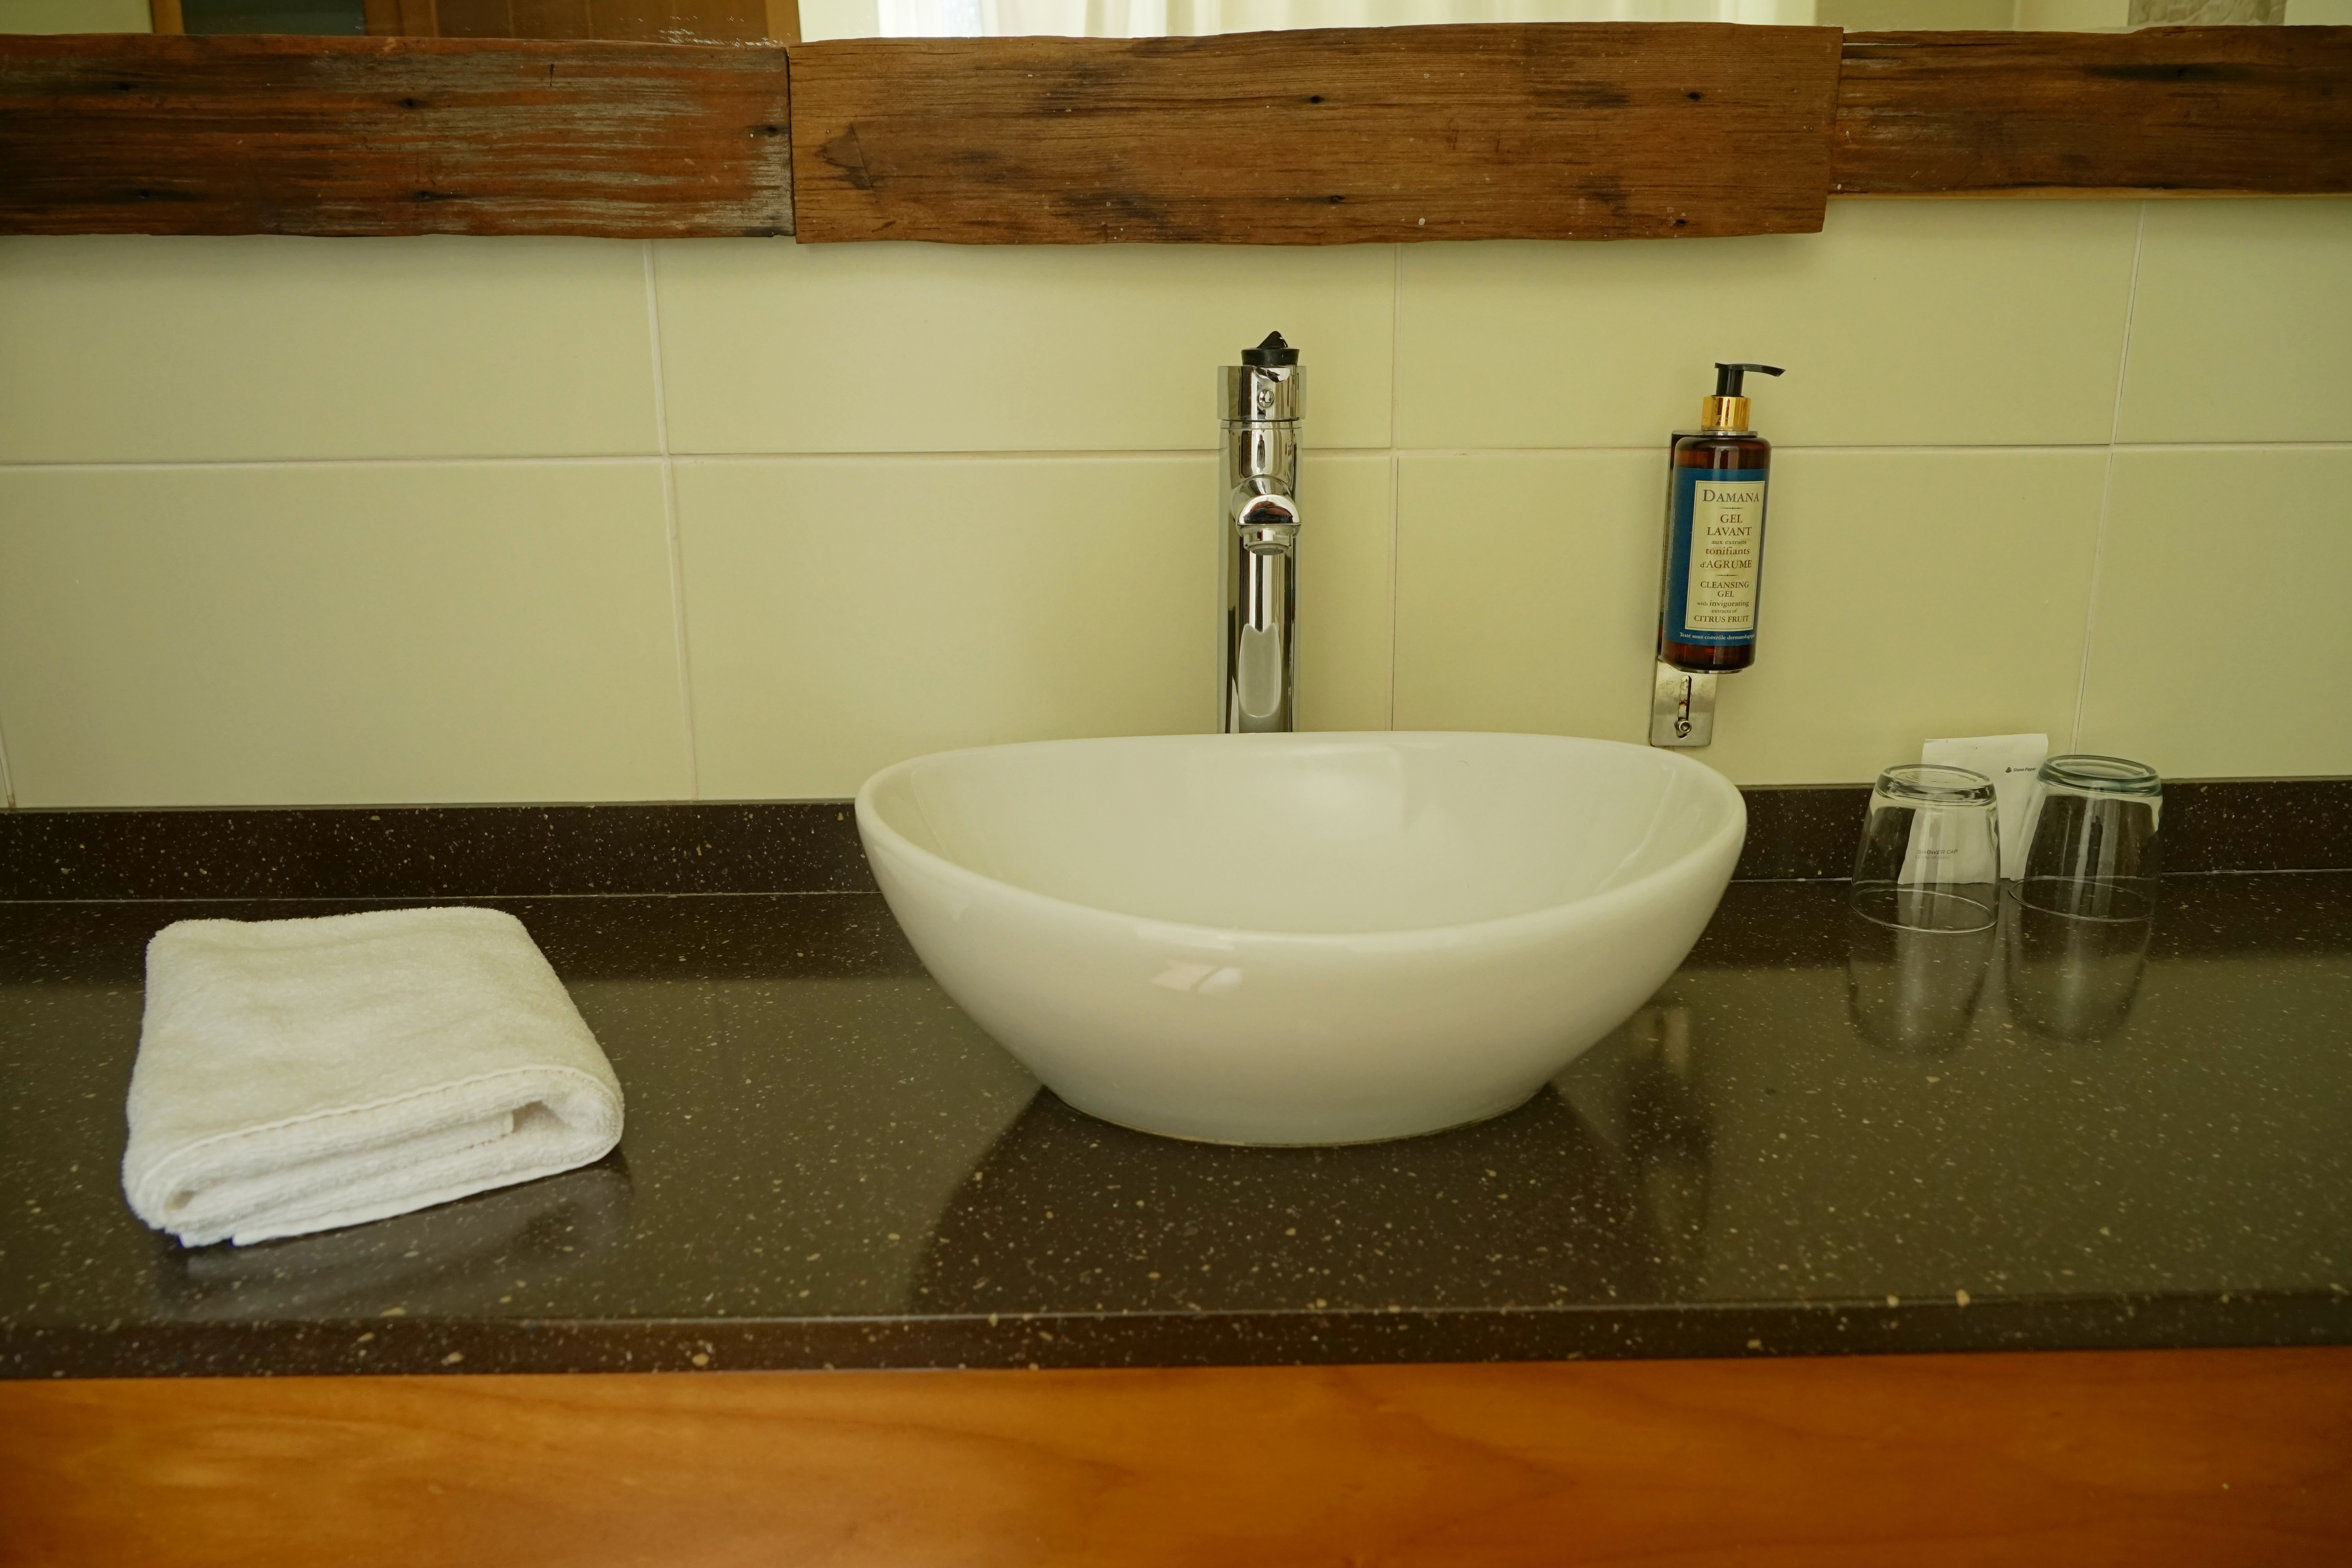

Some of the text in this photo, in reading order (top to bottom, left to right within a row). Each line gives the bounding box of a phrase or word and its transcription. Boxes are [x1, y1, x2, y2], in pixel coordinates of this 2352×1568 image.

[1721, 514, 1743, 523] GEL
[1707, 527, 1752, 536] LAVANT
[1706, 546, 1750, 555] tonifiants
[1700, 560, 1752, 569] d'AGRUME
[1710, 600, 1749, 608] invigorating
